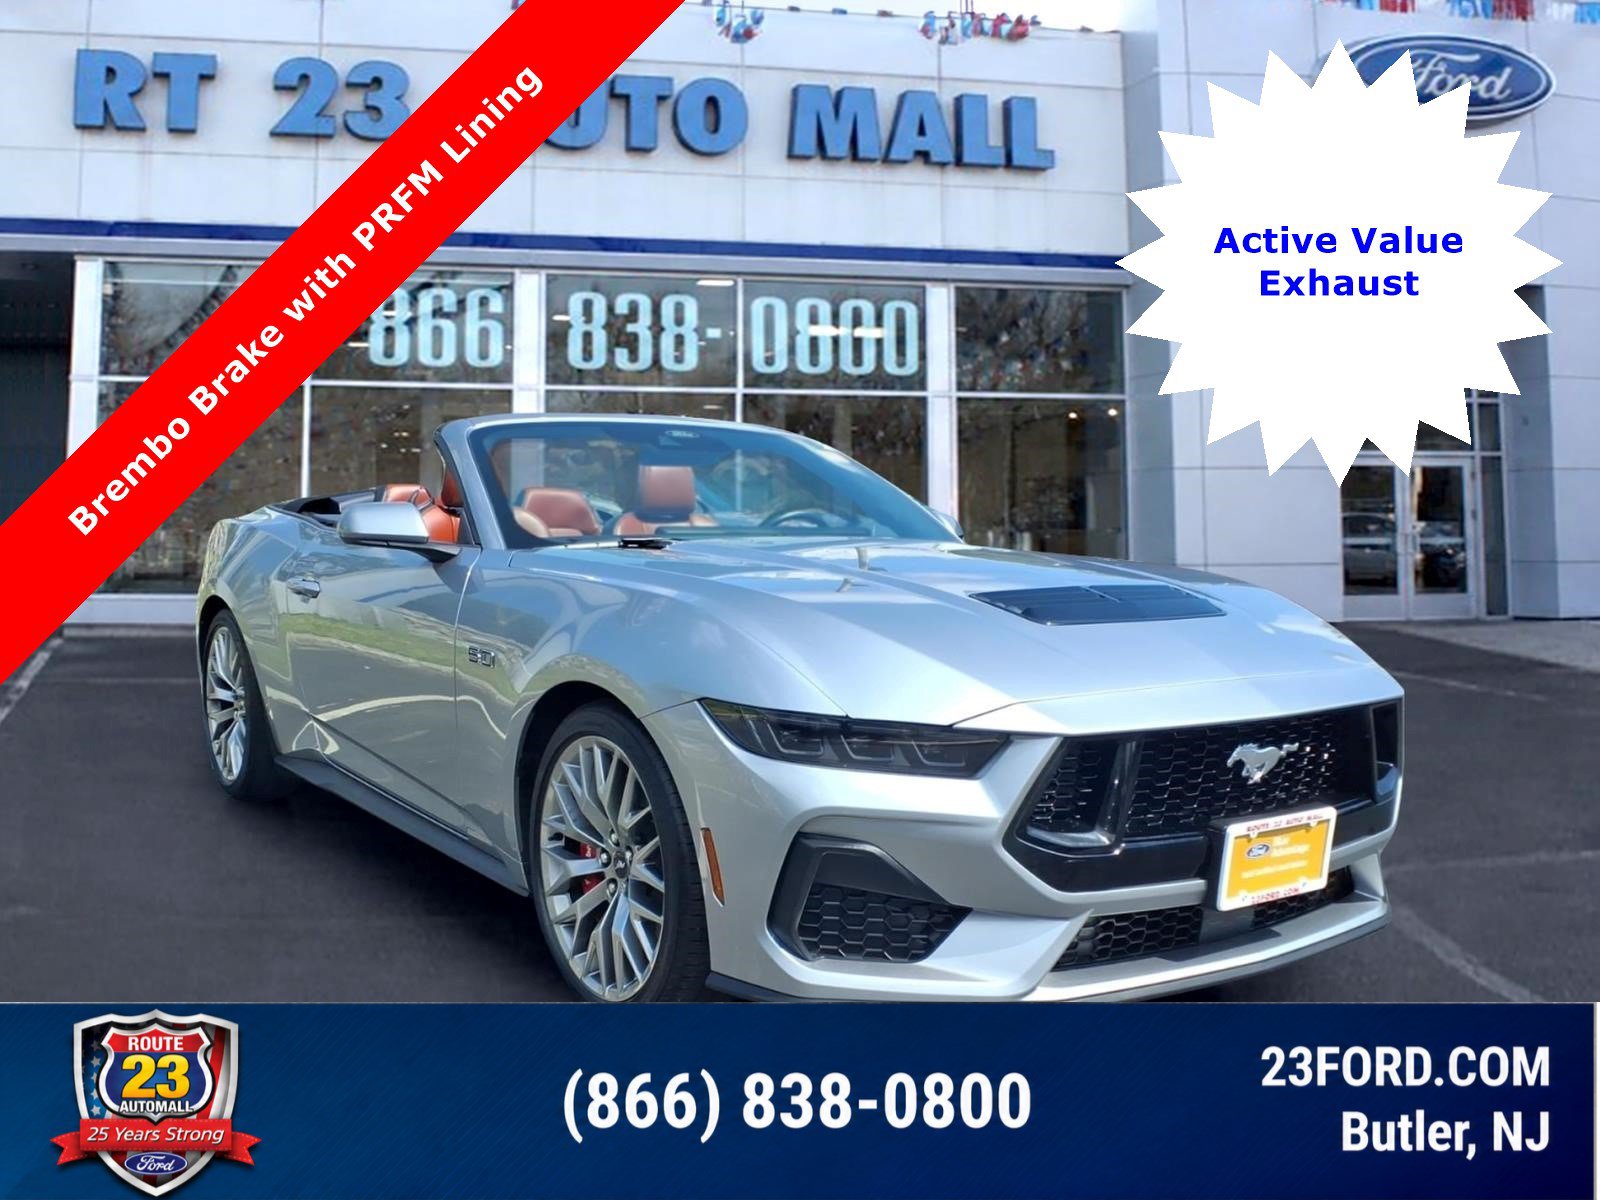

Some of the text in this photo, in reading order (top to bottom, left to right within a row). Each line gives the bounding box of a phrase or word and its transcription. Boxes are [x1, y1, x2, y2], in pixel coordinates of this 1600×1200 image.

[74, 47, 1055, 171] RT 23 UTO MALL
[368, 288, 505, 368] 866
